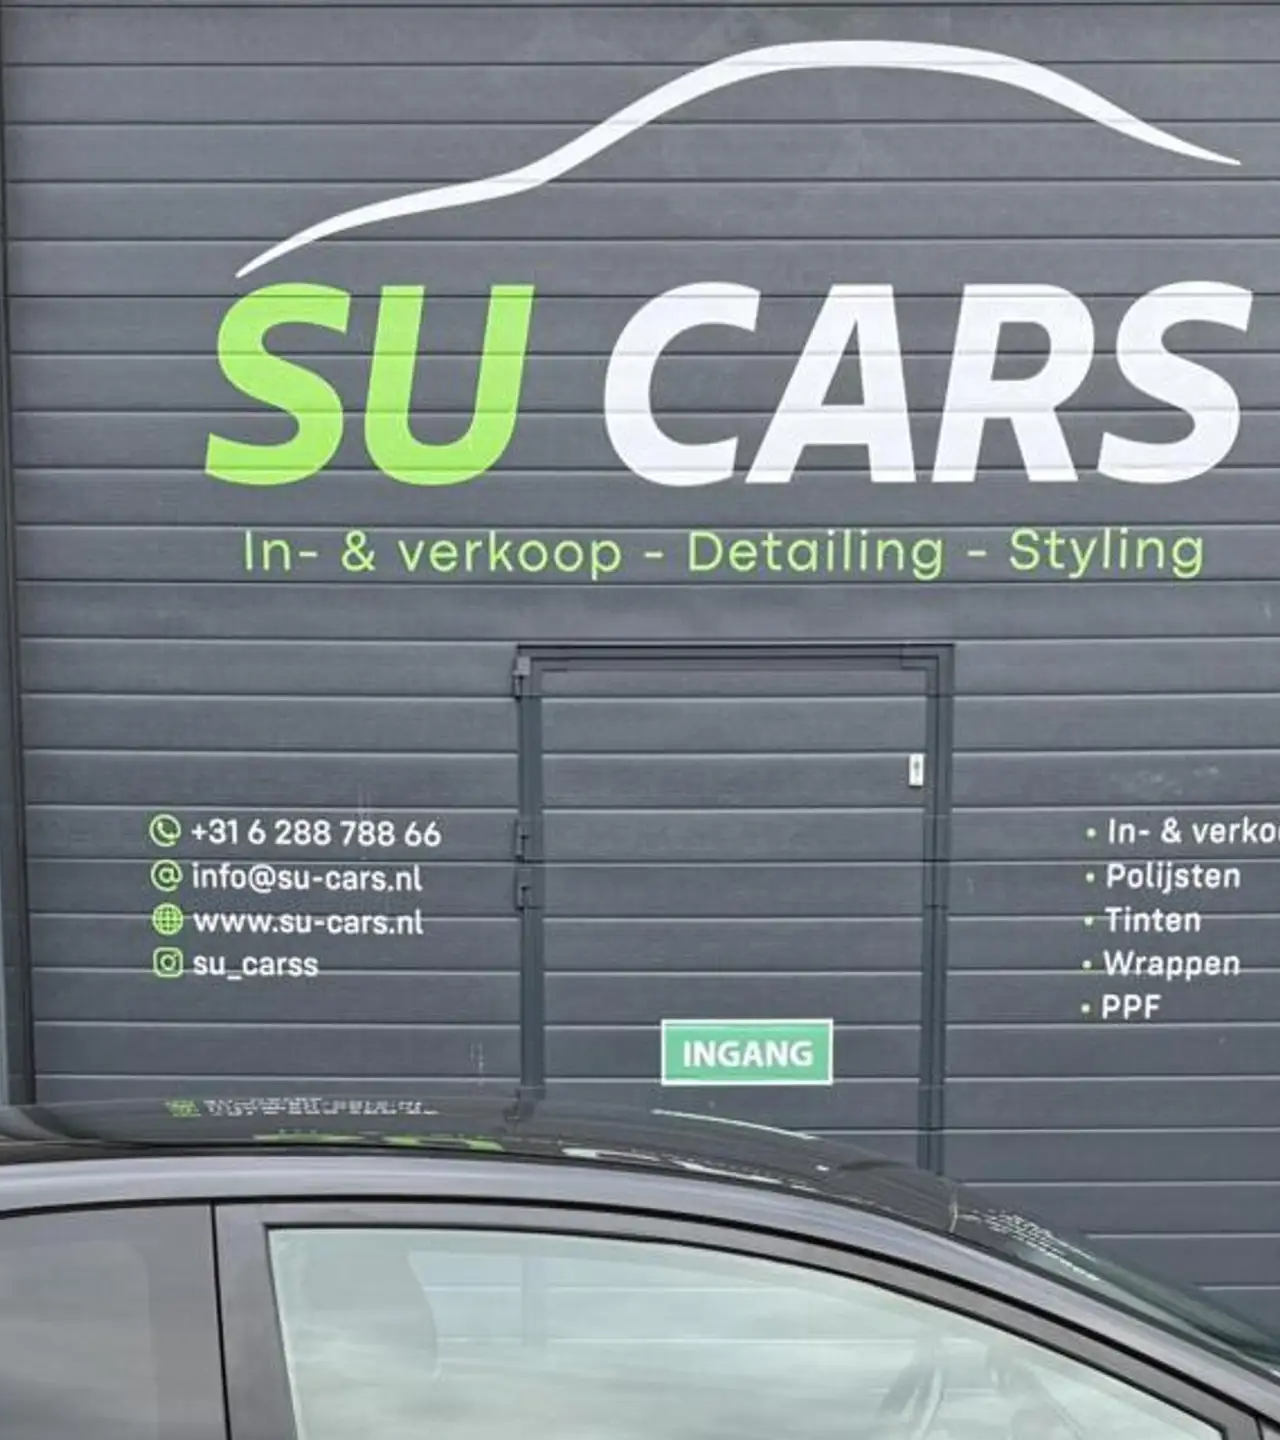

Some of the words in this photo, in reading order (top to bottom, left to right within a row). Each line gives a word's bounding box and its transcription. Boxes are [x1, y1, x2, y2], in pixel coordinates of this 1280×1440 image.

[204, 281, 536, 489] SU
[603, 280, 1254, 487] CARS
[242, 531, 319, 571] In-
[339, 531, 377, 573] &
[402, 530, 623, 583] verkoop
[688, 530, 946, 582] Detailing
[1008, 528, 1206, 580] Styling
[191, 818, 238, 846] +31
[247, 818, 266, 846] 6
[274, 818, 333, 847] 288
[340, 820, 396, 848] 788
[404, 820, 443, 848] 66
[1107, 817, 1150, 845] In-
[1160, 817, 1182, 845] &
[192, 860, 424, 895] info@su-cars.nl
[1106, 860, 1242, 893] Polijsten
[192, 905, 425, 936] www.su-cars.nl
[1104, 905, 1202, 934] Tinten
[192, 949, 321, 984] su_carss
[1103, 950, 1242, 980] Wrappen
[1101, 993, 1162, 1021] PPF
[682, 1040, 814, 1068] INGANG
